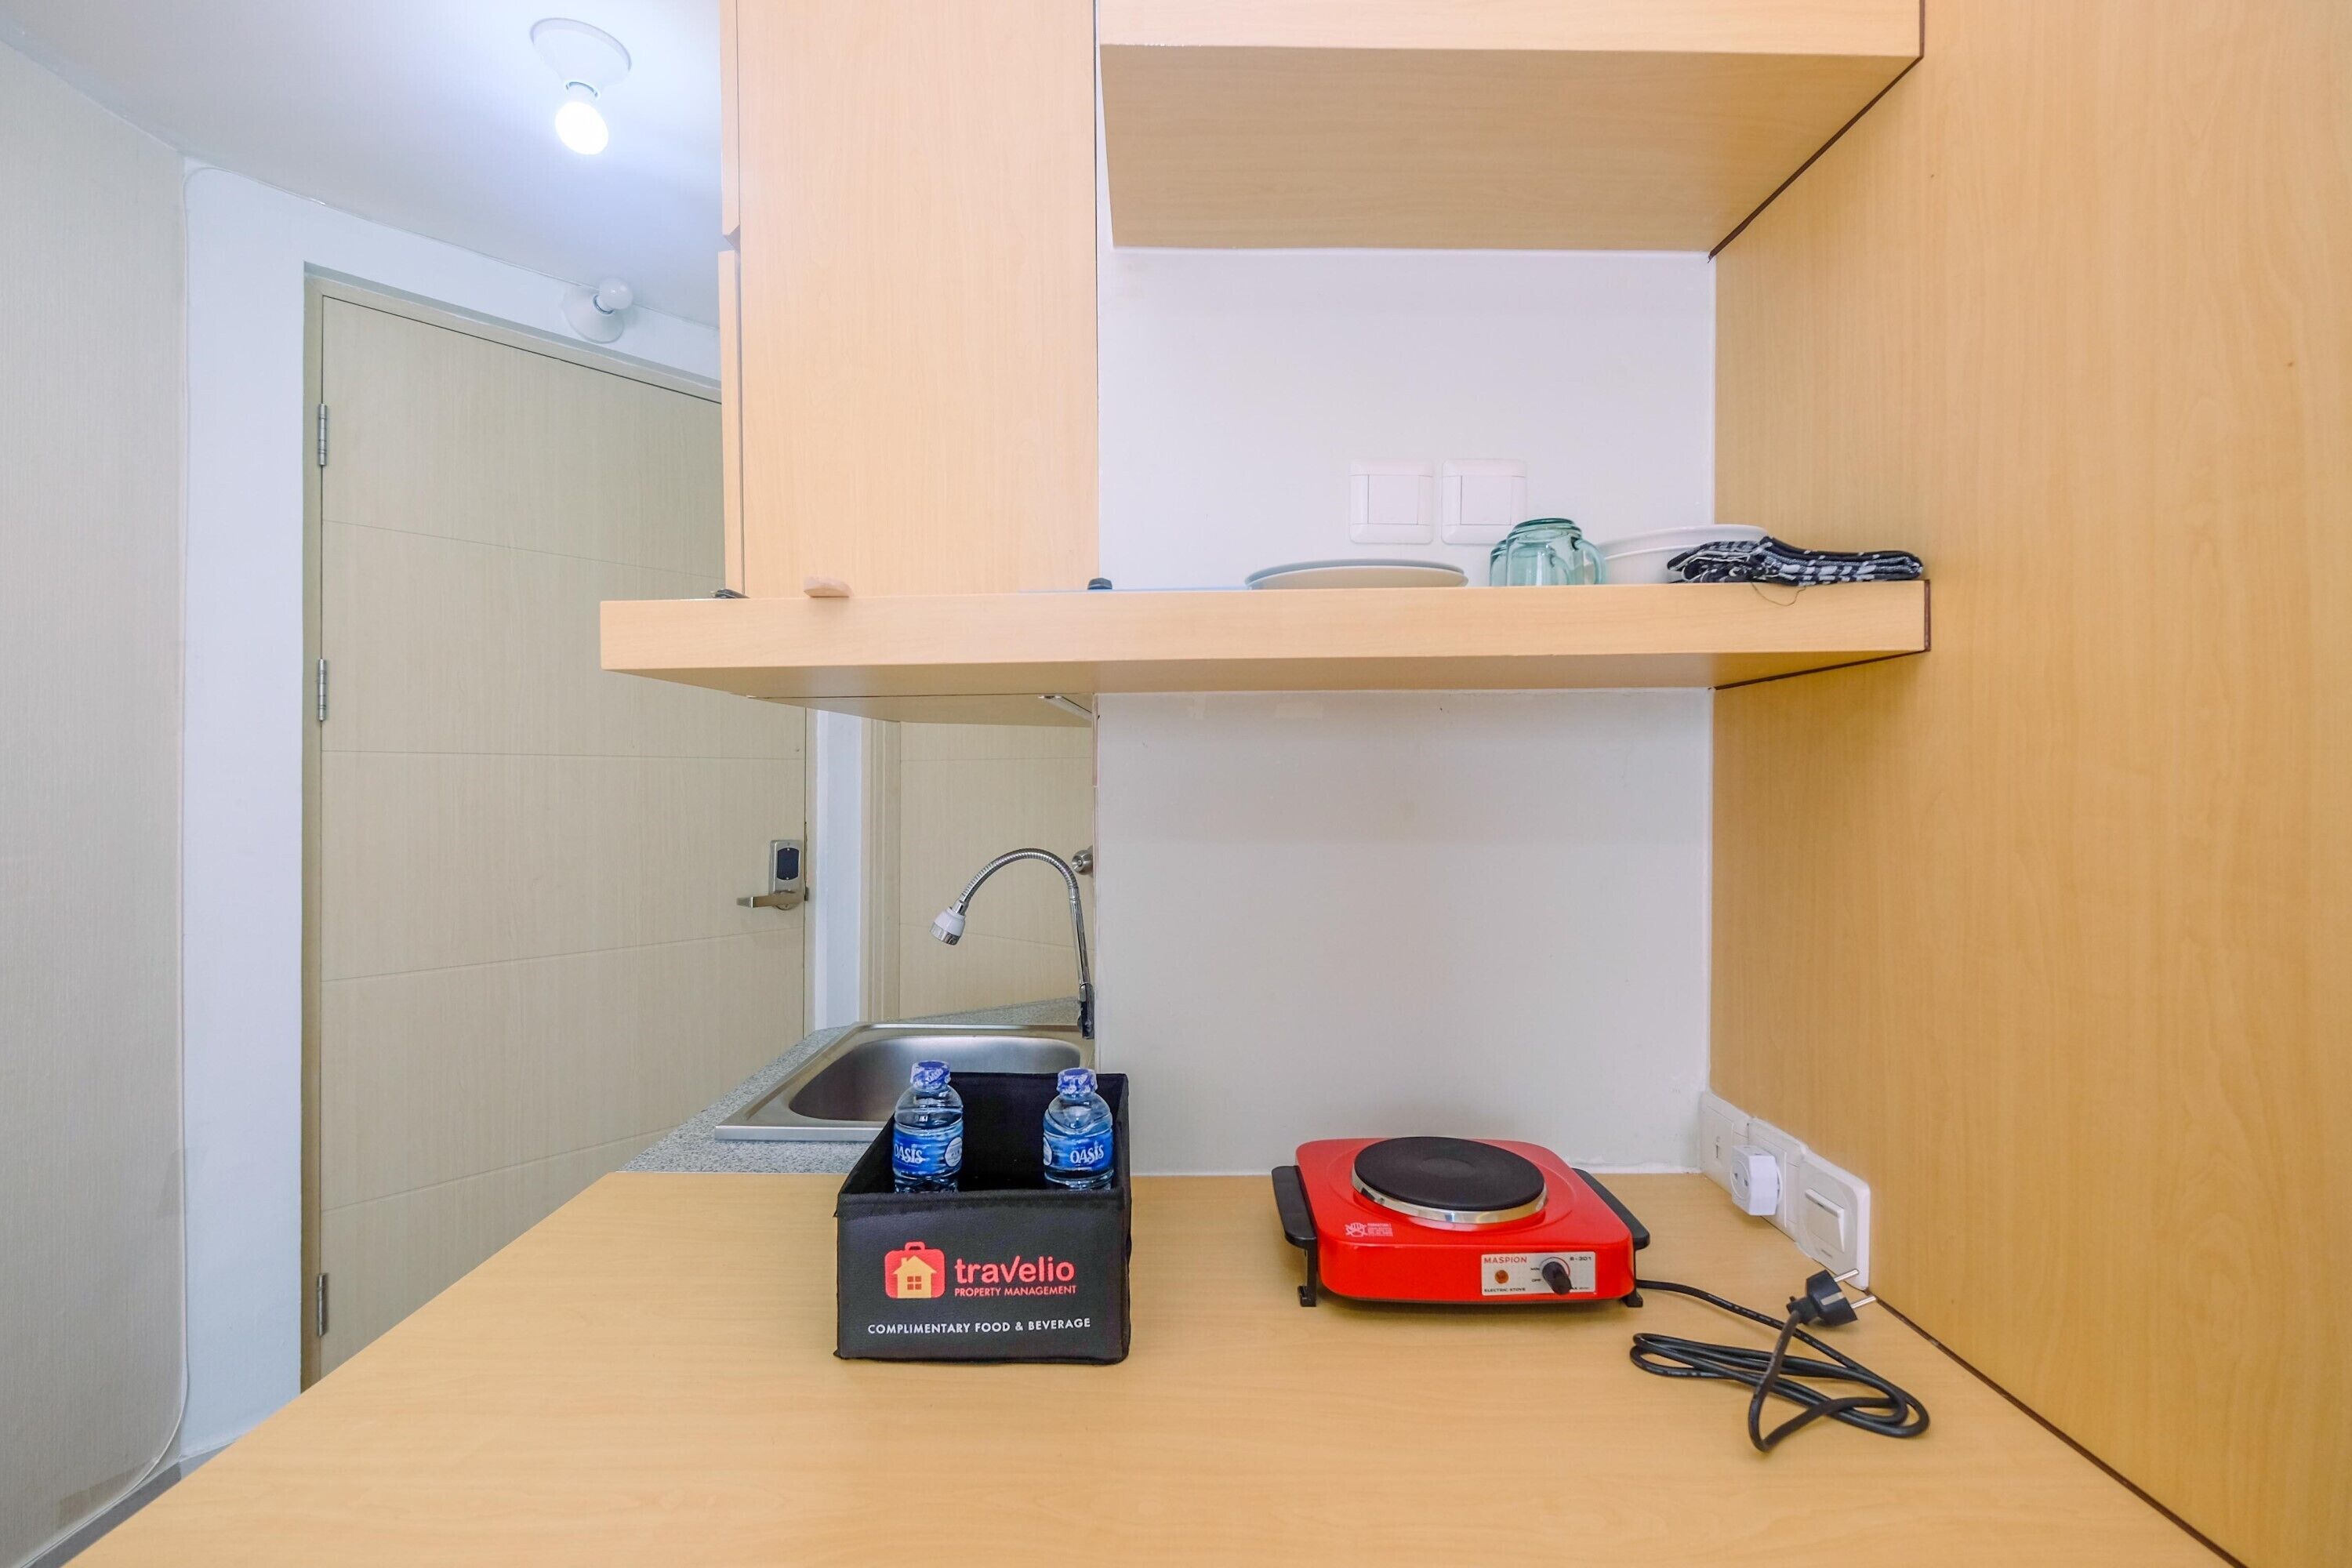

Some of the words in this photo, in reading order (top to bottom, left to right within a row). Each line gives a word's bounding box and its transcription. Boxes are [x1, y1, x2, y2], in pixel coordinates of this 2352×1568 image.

[1069, 1141, 1105, 1165] OASIS
[954, 1256, 1076, 1283] travelio
[954, 1287, 1000, 1298] PROPERTY
[1004, 1285, 1077, 1296] MANAGEMENT
[867, 1323, 971, 1334] COMPLIMENTARY
[975, 1322, 1011, 1333] FOOD
[1014, 1321, 1023, 1332] &
[1028, 1317, 1091, 1331] BEVERAGE
